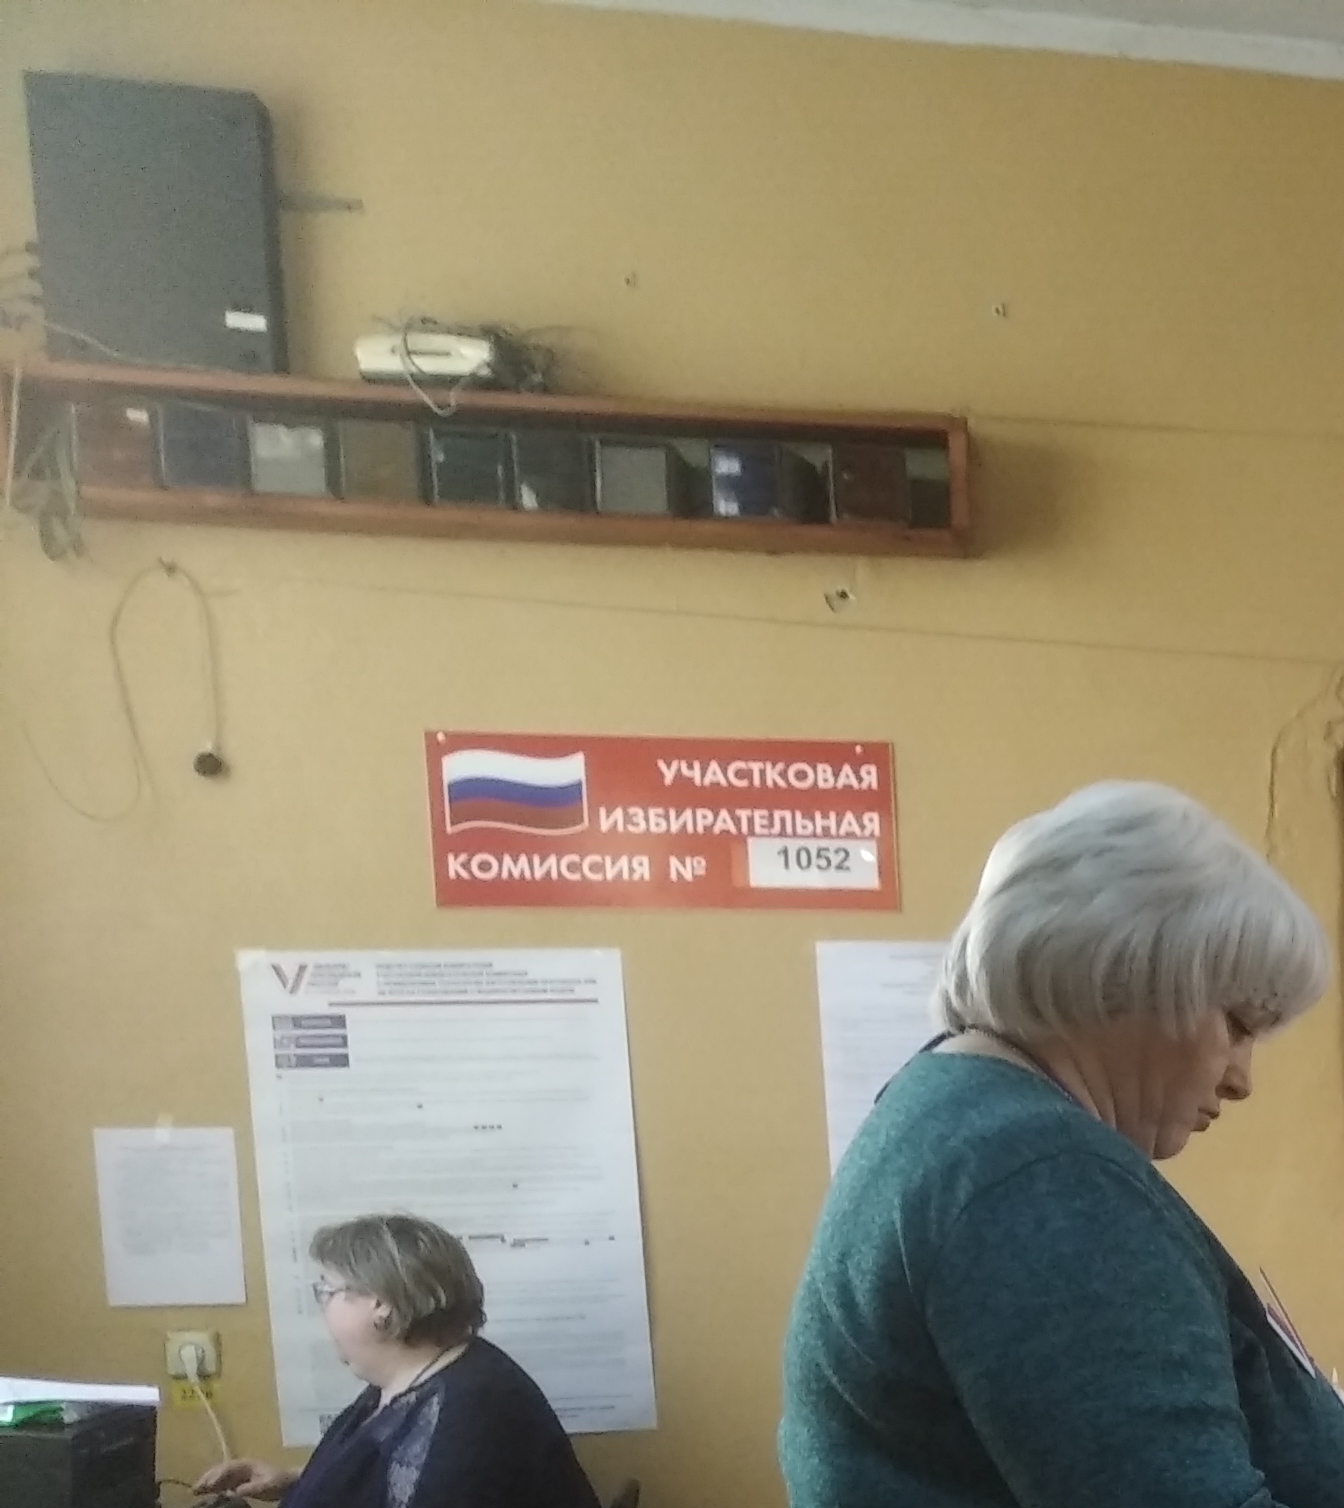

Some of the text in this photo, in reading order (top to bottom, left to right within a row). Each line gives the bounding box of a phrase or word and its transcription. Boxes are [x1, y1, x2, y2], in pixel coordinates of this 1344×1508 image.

[656, 758, 879, 791] УЧАСТКОВАЯ
[599, 806, 880, 838] ИЗБИРАТЕЛЬНАЯ
[447, 845, 852, 882] КОМИССИЯ № 1052
